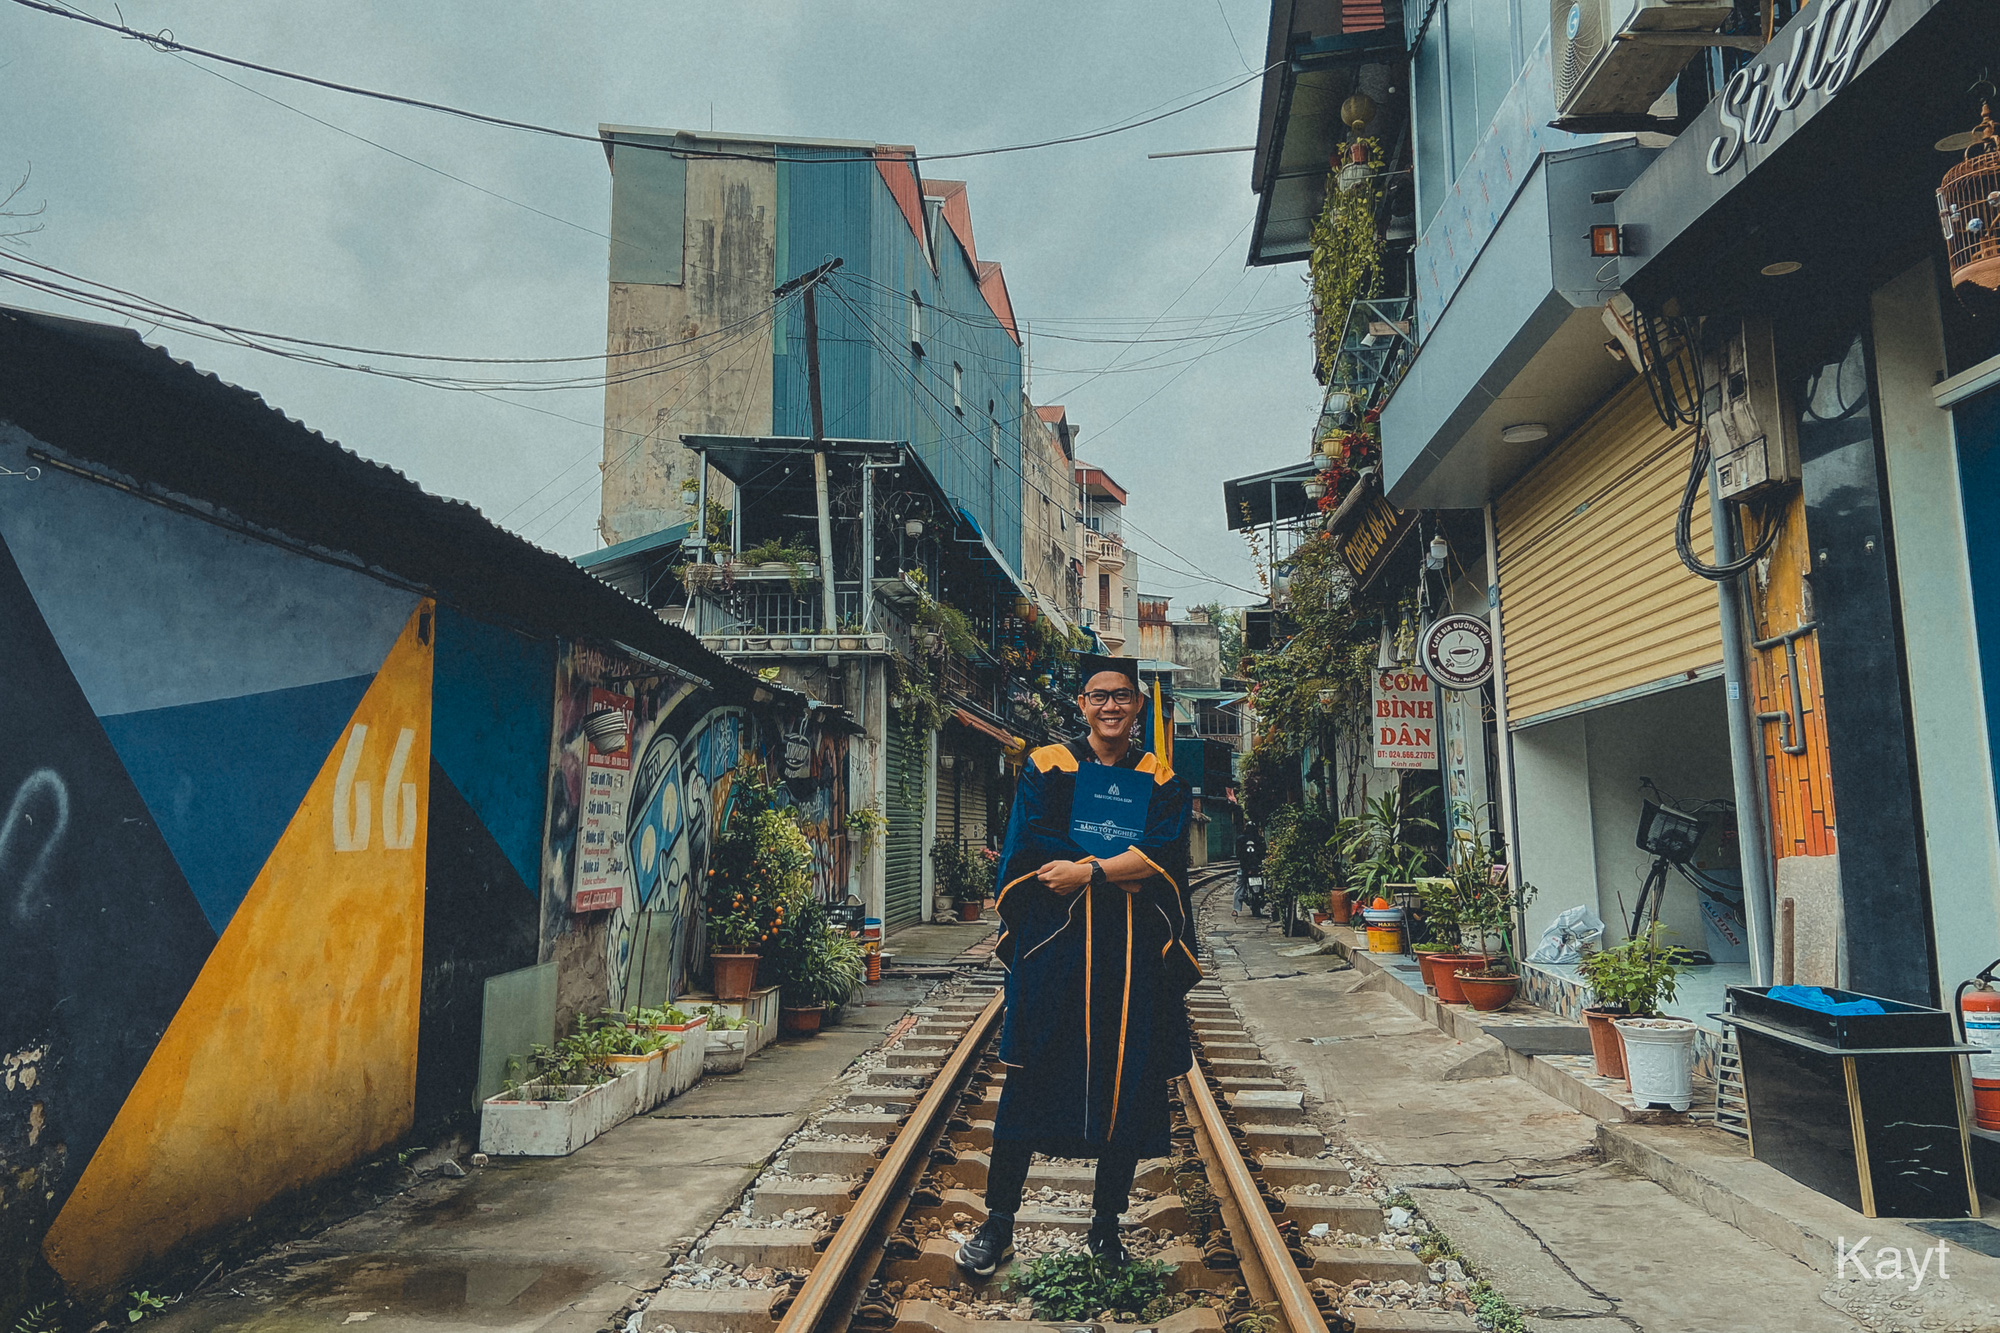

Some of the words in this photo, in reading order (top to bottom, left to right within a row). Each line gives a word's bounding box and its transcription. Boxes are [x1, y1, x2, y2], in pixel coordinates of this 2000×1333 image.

[1345, 521, 1379, 575] COFFEE
[1441, 625, 1453, 634] BIA
[1376, 694, 1434, 718] BÌNH
[1380, 722, 1432, 746] DÂN
[332, 722, 417, 852] 66
